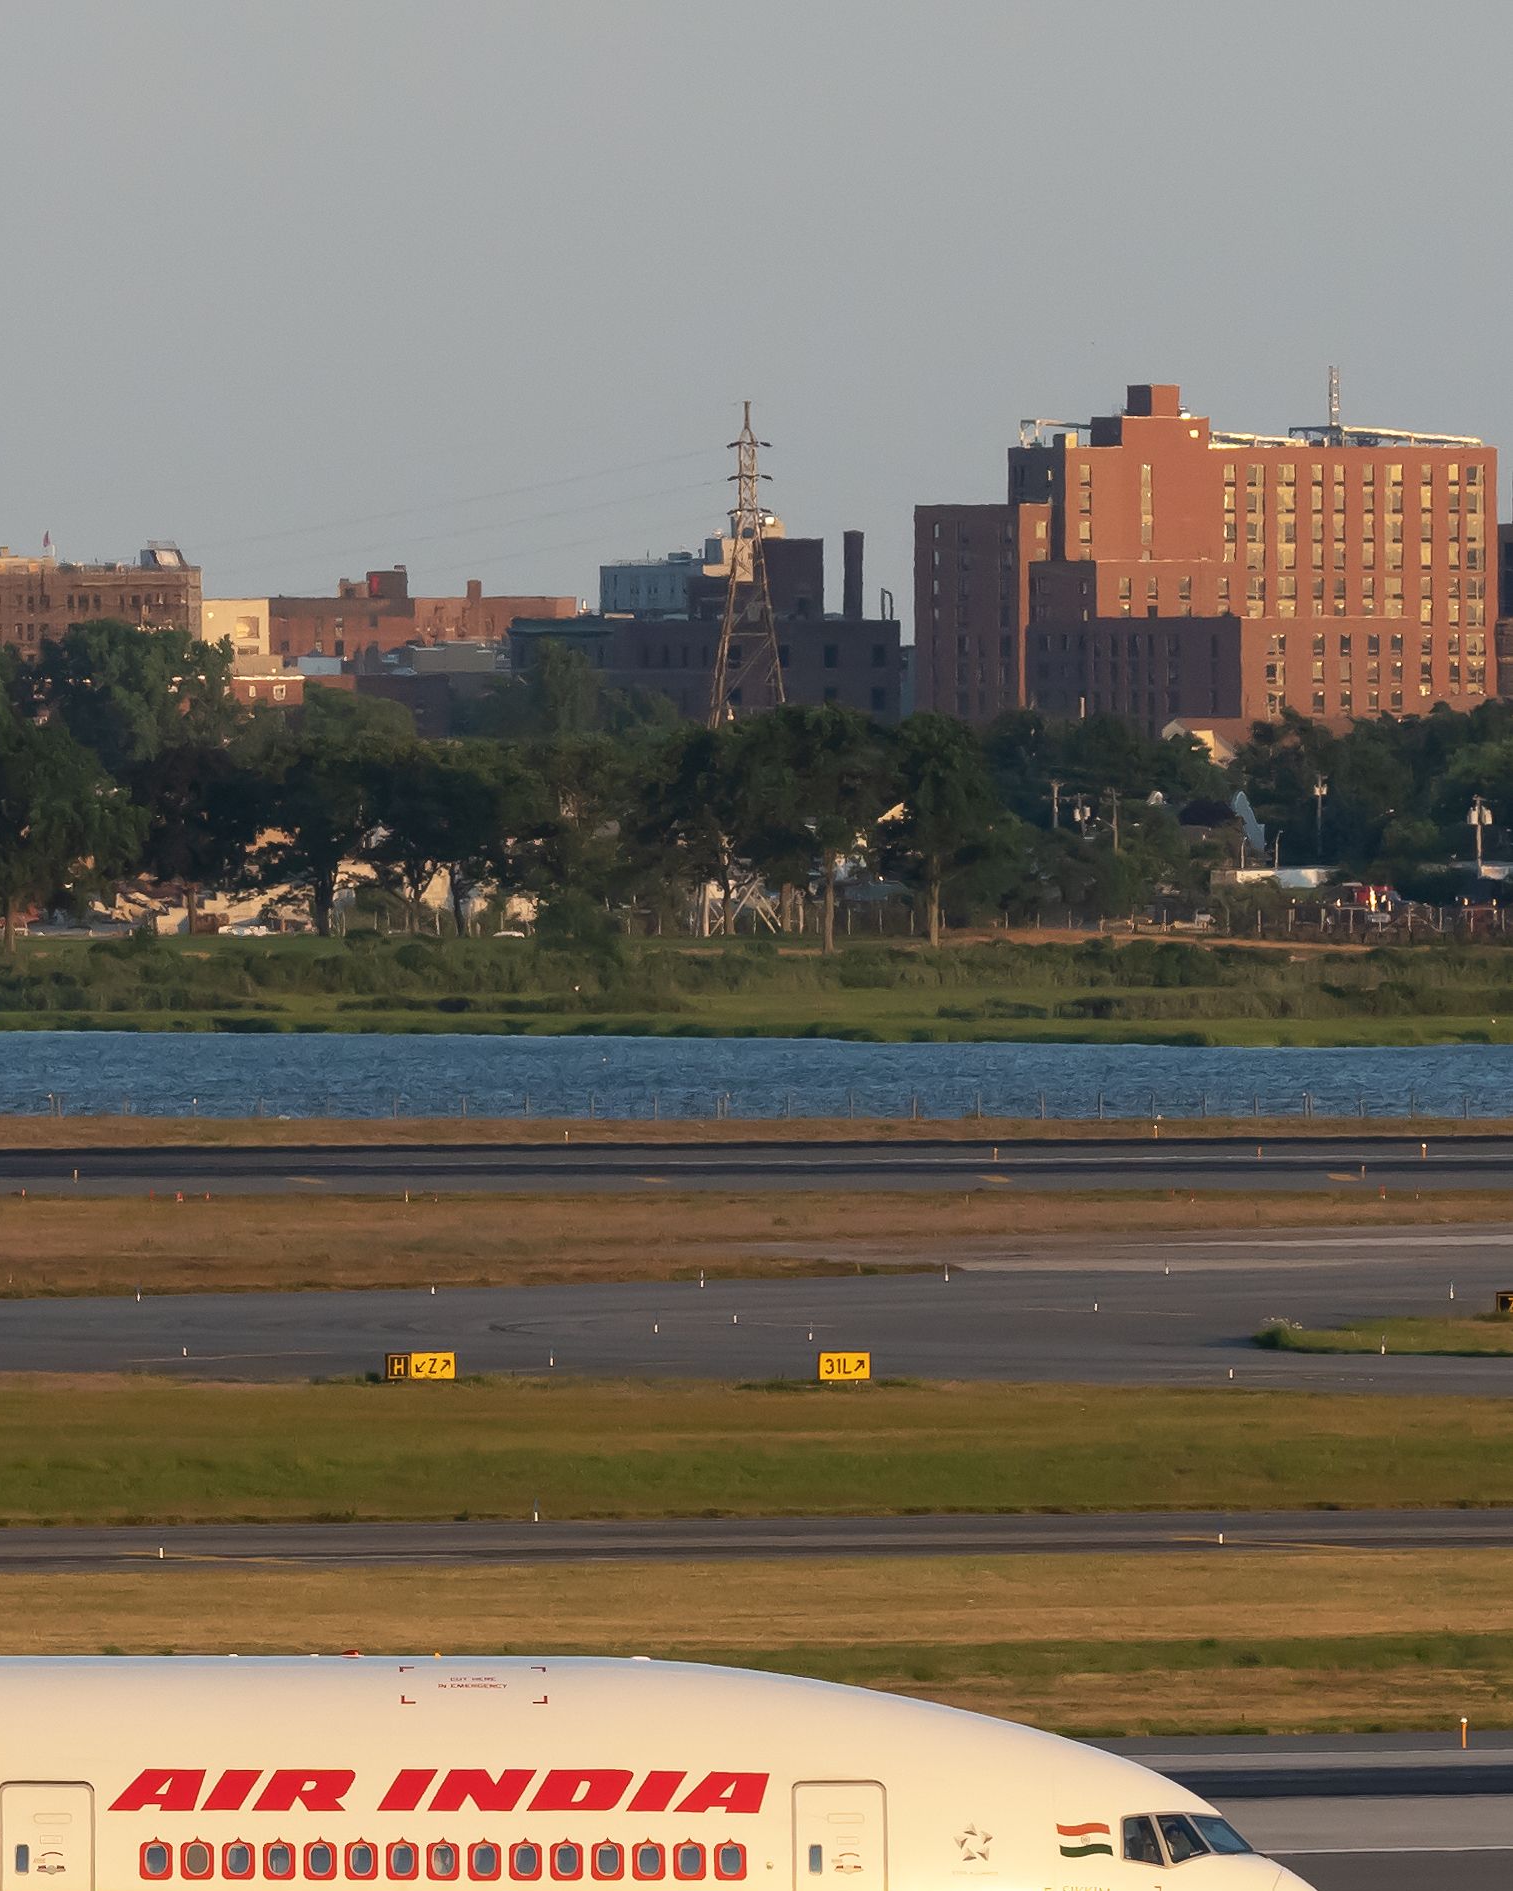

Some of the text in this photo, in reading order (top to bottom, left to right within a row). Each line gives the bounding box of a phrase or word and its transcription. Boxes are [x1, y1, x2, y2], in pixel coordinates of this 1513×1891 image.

[393, 1358, 438, 1375] H Z
[825, 1358, 852, 1375] 31L
[110, 1768, 769, 1814] AIR INDIA
